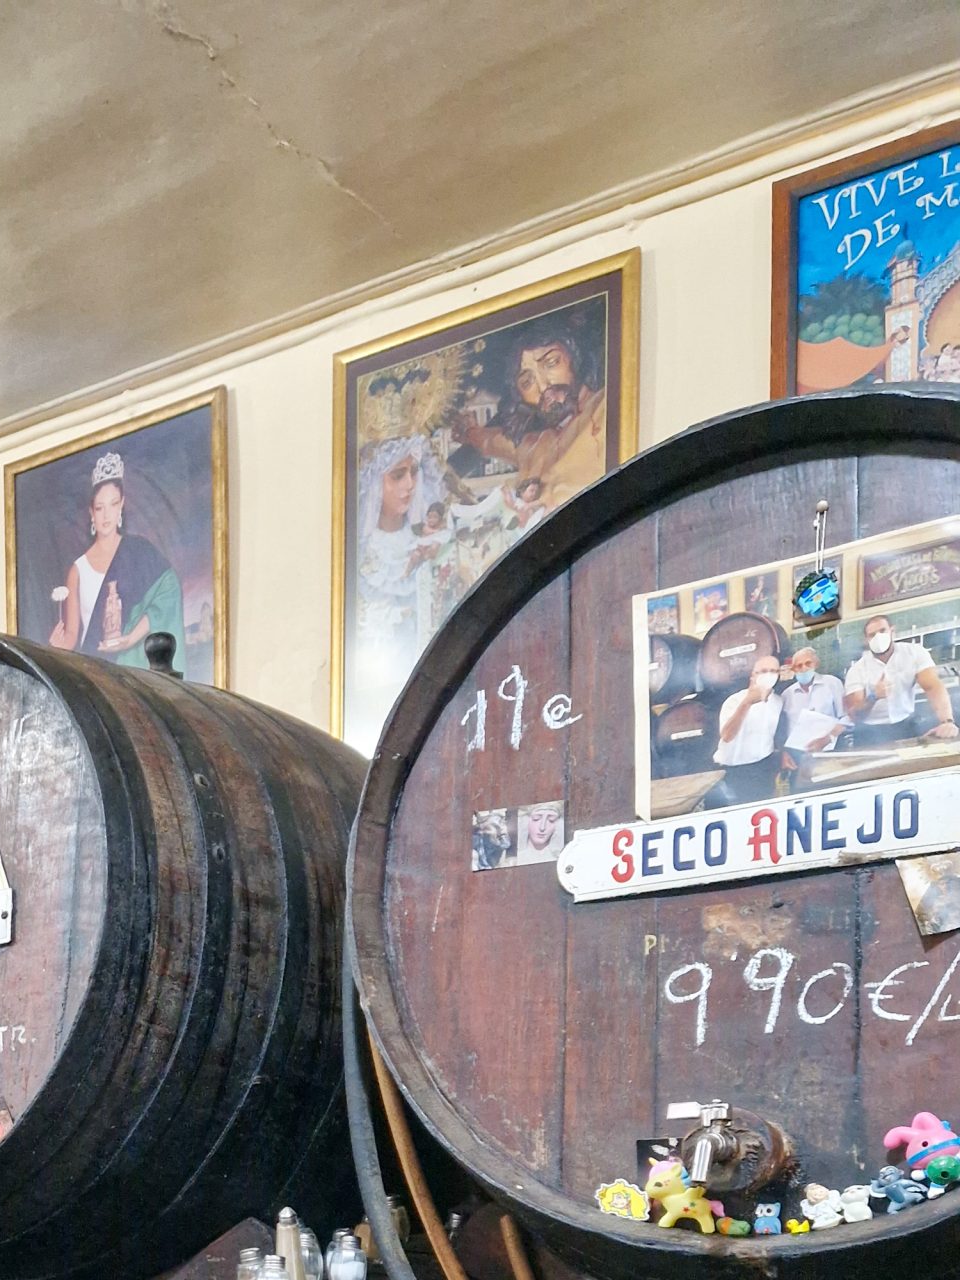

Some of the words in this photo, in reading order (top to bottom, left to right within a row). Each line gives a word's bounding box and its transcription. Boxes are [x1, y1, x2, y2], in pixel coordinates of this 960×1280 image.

[811, 161, 925, 231] VIVE
[938, 151, 960, 178] L
[837, 209, 900, 270] DE
[916, 182, 960, 221] M
[611, 820, 727, 883] SECO
